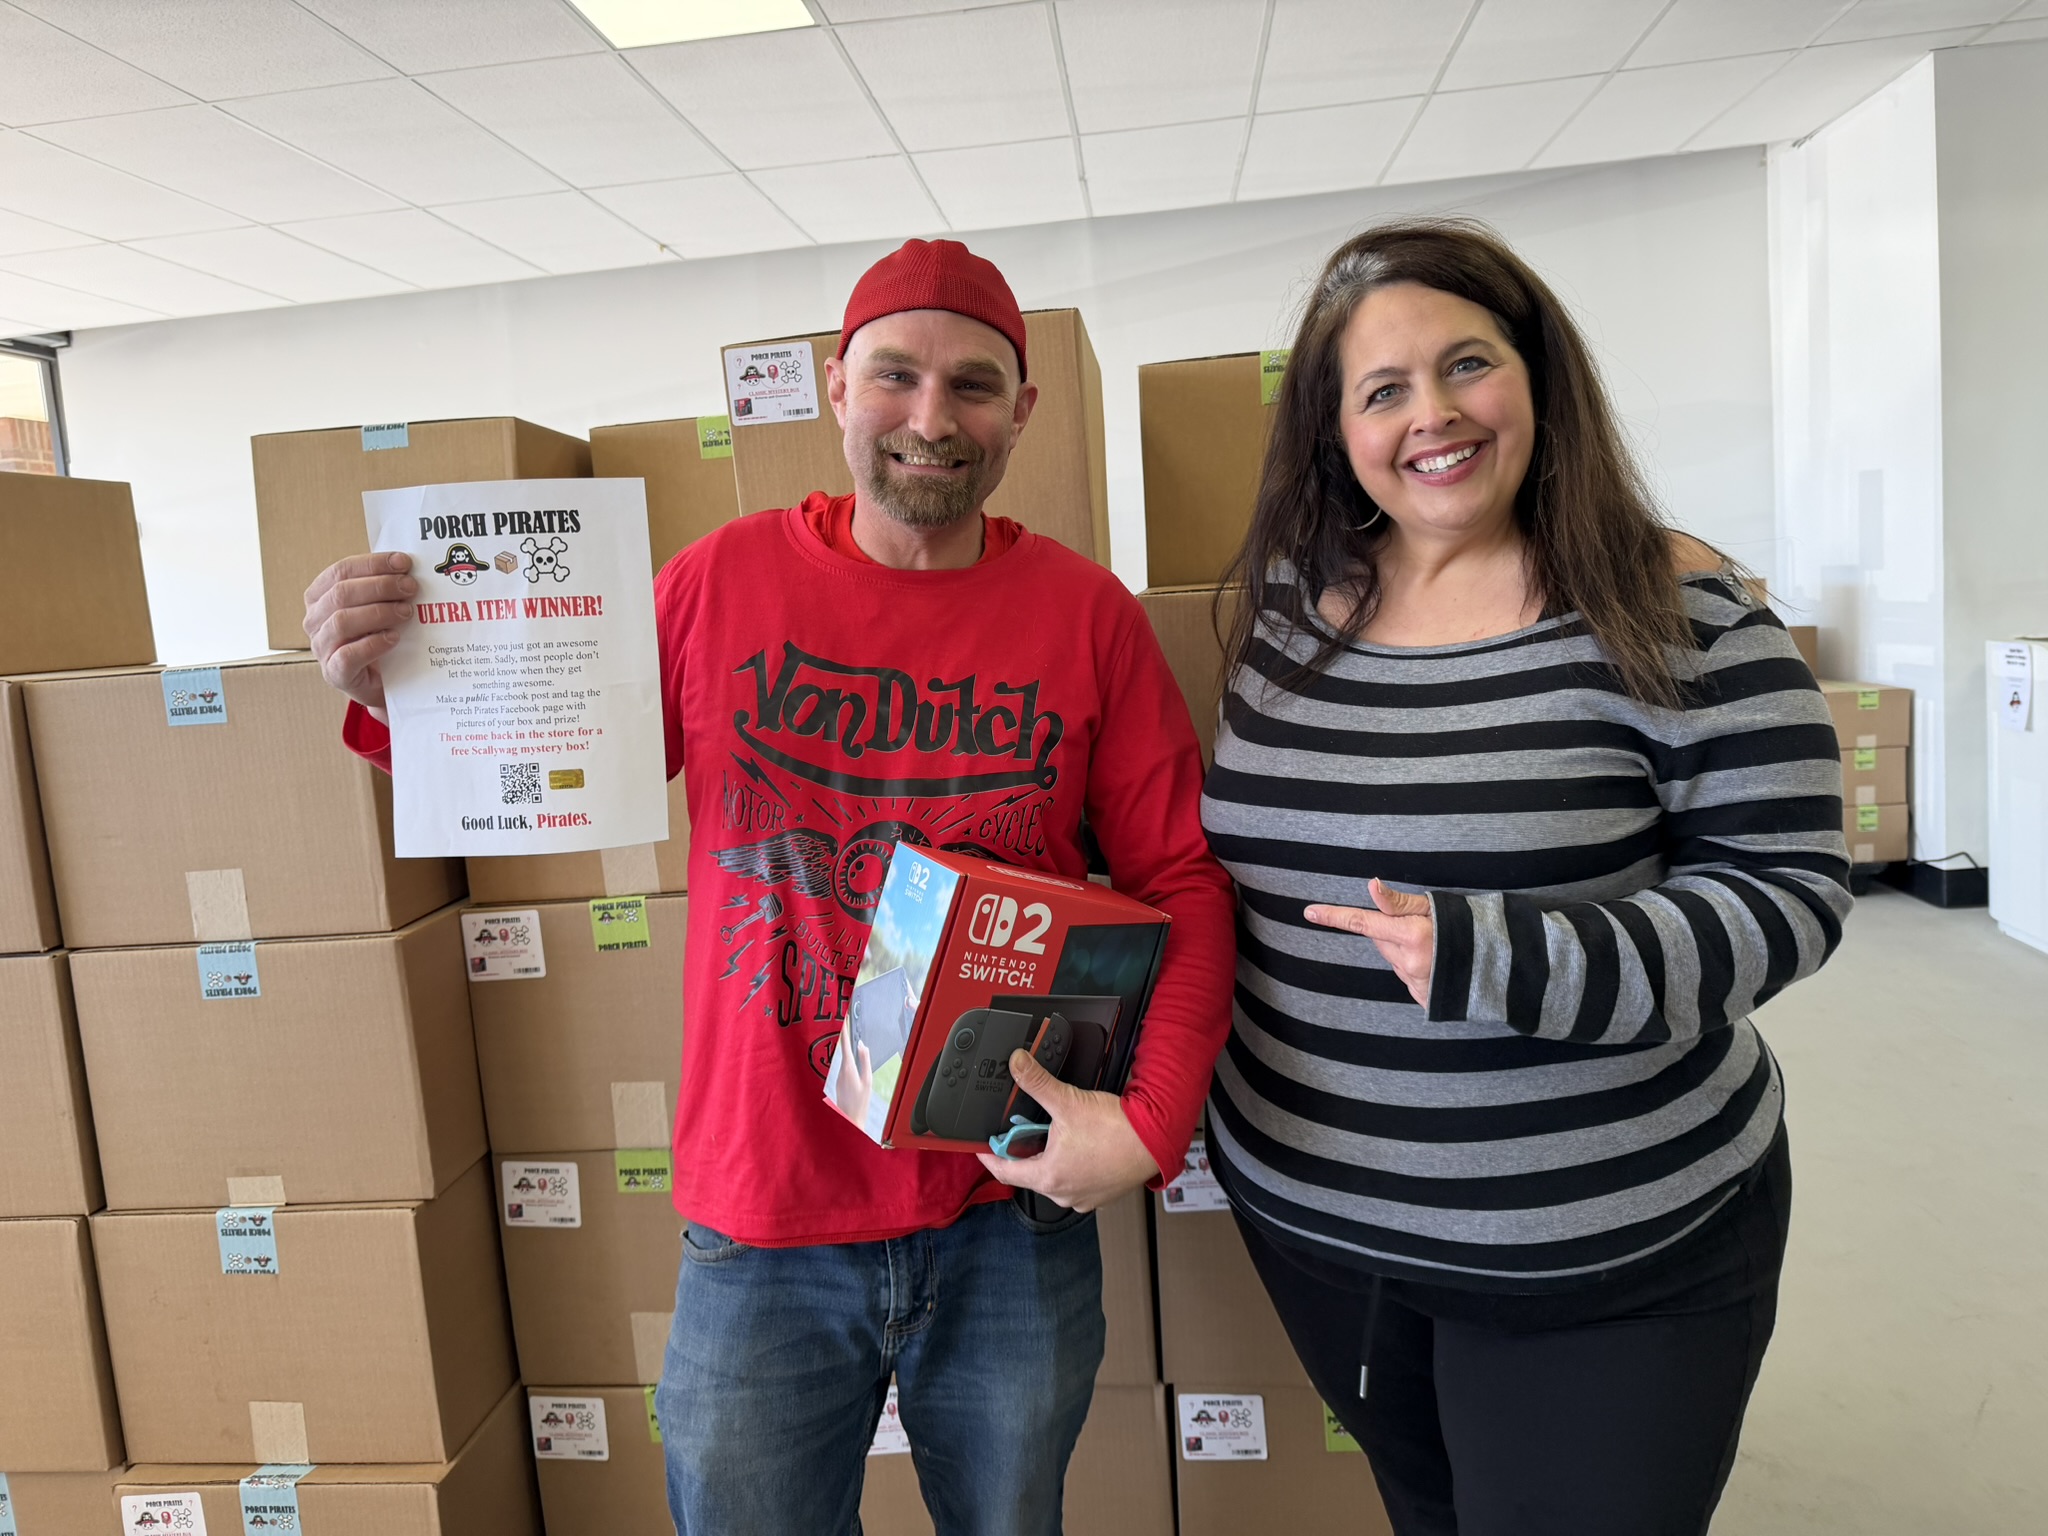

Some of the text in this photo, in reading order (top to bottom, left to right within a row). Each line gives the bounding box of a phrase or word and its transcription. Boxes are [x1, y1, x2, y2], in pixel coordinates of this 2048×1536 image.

[751, 351, 792, 361] PORCH PIRATES
[418, 509, 581, 540] PORCH PIRATES
[416, 595, 603, 624] ULTRA ITEM WINNER!
[428, 645, 464, 656] Congrats
[466, 643, 492, 654] Matey,
[493, 644, 508, 654] you
[509, 642, 524, 652] just
[526, 642, 540, 651] got
[556, 640, 598, 648] awesome
[430, 651, 600, 668] high-ticket item. Sadly, most people don't
[448, 665, 582, 678] let the world know when they get
[472, 680, 555, 690] something awesome.
[436, 694, 458, 703] Make
[465, 694, 490, 704] public
[491, 692, 529, 702] Facebook
[530, 692, 550, 702] post
[552, 690, 568, 698] and
[570, 690, 585, 700] tag
[586, 688, 601, 696] the
[170, 704, 223, 716] PORCH PIRATES
[450, 702, 586, 716] Porch Pirates Facebook page with
[456, 714, 580, 729] pictures of your box and prize!
[438, 732, 462, 742] Then
[490, 731, 513, 740] back
[515, 730, 525, 739] in
[528, 730, 544, 738] the
[548, 729, 575, 738] store
[578, 727, 594, 736] for
[451, 741, 590, 756] free Scallywag mystery box!
[722, 770, 786, 833] MOTOR
[461, 812, 592, 831] Good Luck, Pirates.
[592, 900, 642, 912] PORCH PIRATES
[502, 916, 521, 924] PIRATES
[1013, 902, 1052, 955] 2
[794, 920, 843, 966] BUILT
[964, 951, 1037, 972] NINTENDO
[958, 963, 1034, 988] SWITCH
[205, 986, 258, 997] PORCH PIRATES
[619, 1168, 668, 1176] PORCH PIRATES
[220, 1228, 271, 1236] PORCH PIRATES
[146, 1500, 162, 1508] PORCH
[244, 1506, 296, 1514] PORCH PIRATES
